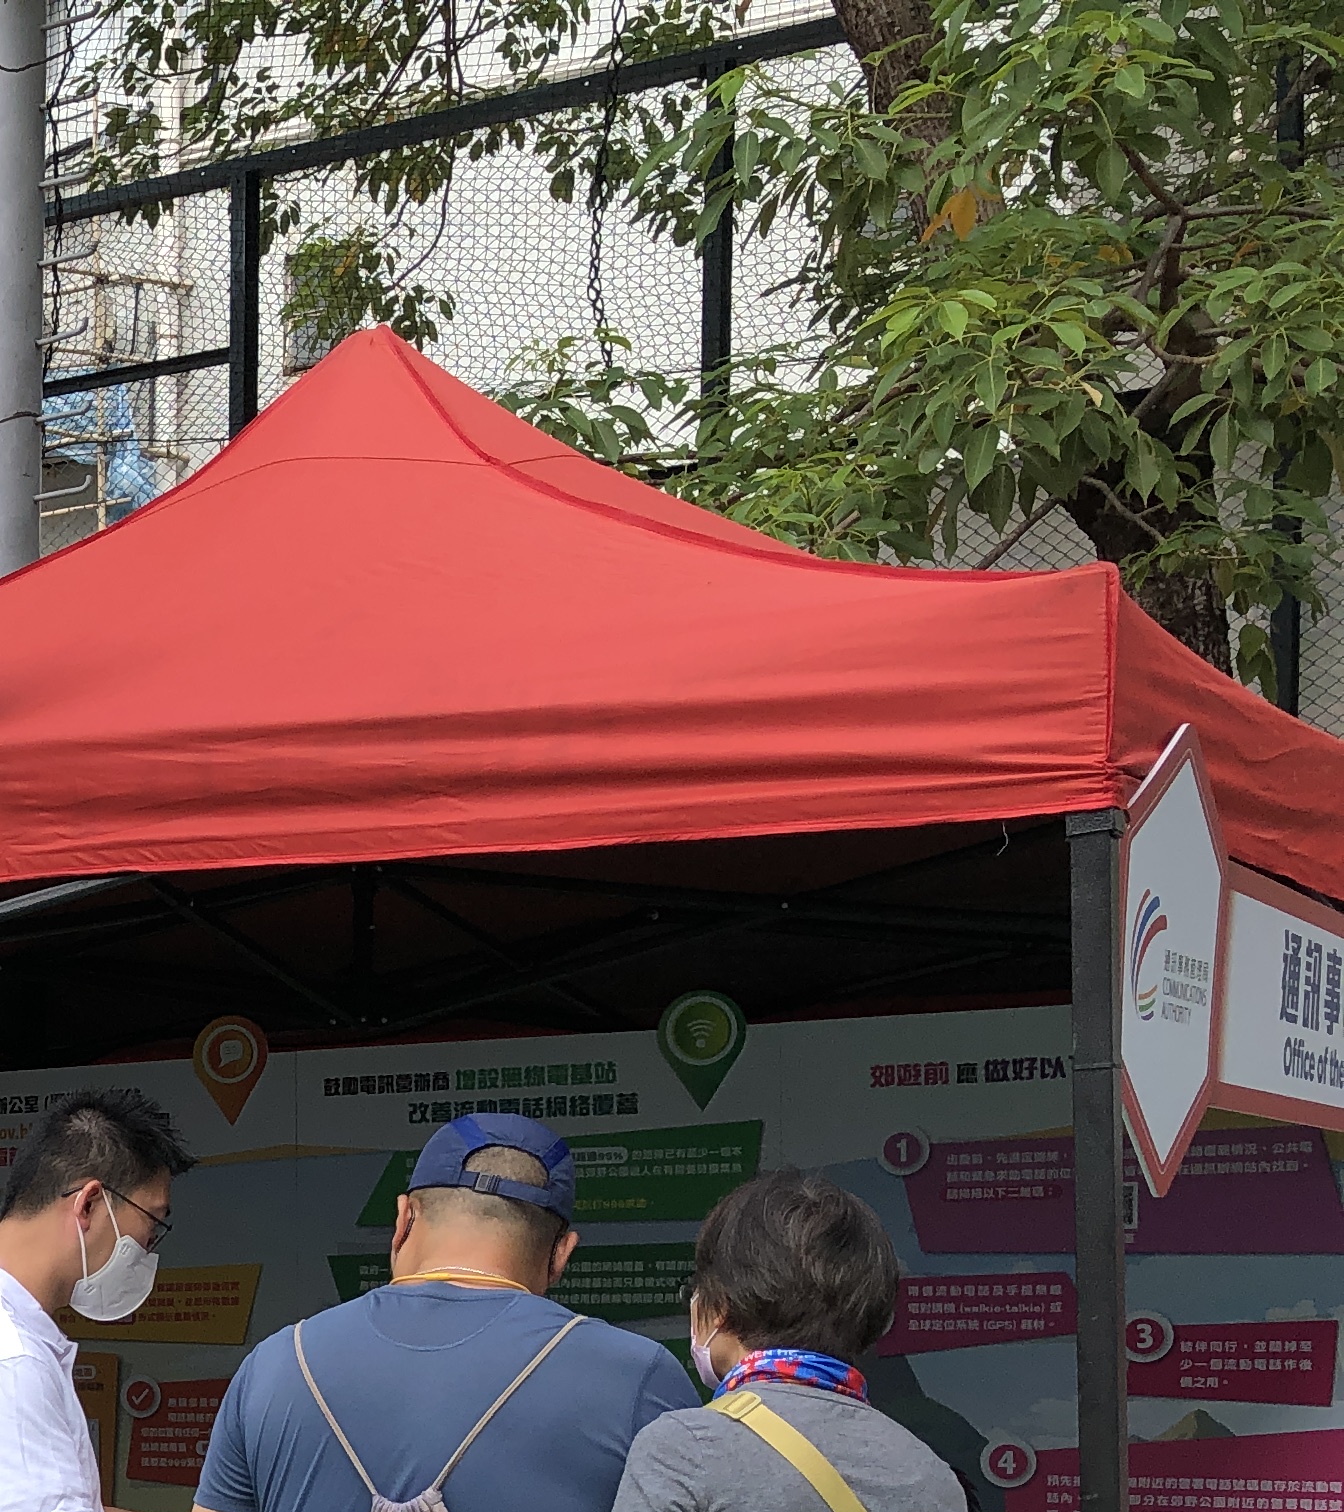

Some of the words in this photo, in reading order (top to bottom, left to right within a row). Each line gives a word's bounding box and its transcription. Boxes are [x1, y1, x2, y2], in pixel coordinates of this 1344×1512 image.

[870, 1062, 949, 1088] 郊遊前
[984, 1055, 1073, 1083] 做好以
[1283, 1036, 1315, 1082] Office
[1316, 1046, 1329, 1085] of
[896, 1138, 908, 1162] 1
[1135, 1324, 1154, 1349] 3
[997, 1451, 1017, 1475] 4
